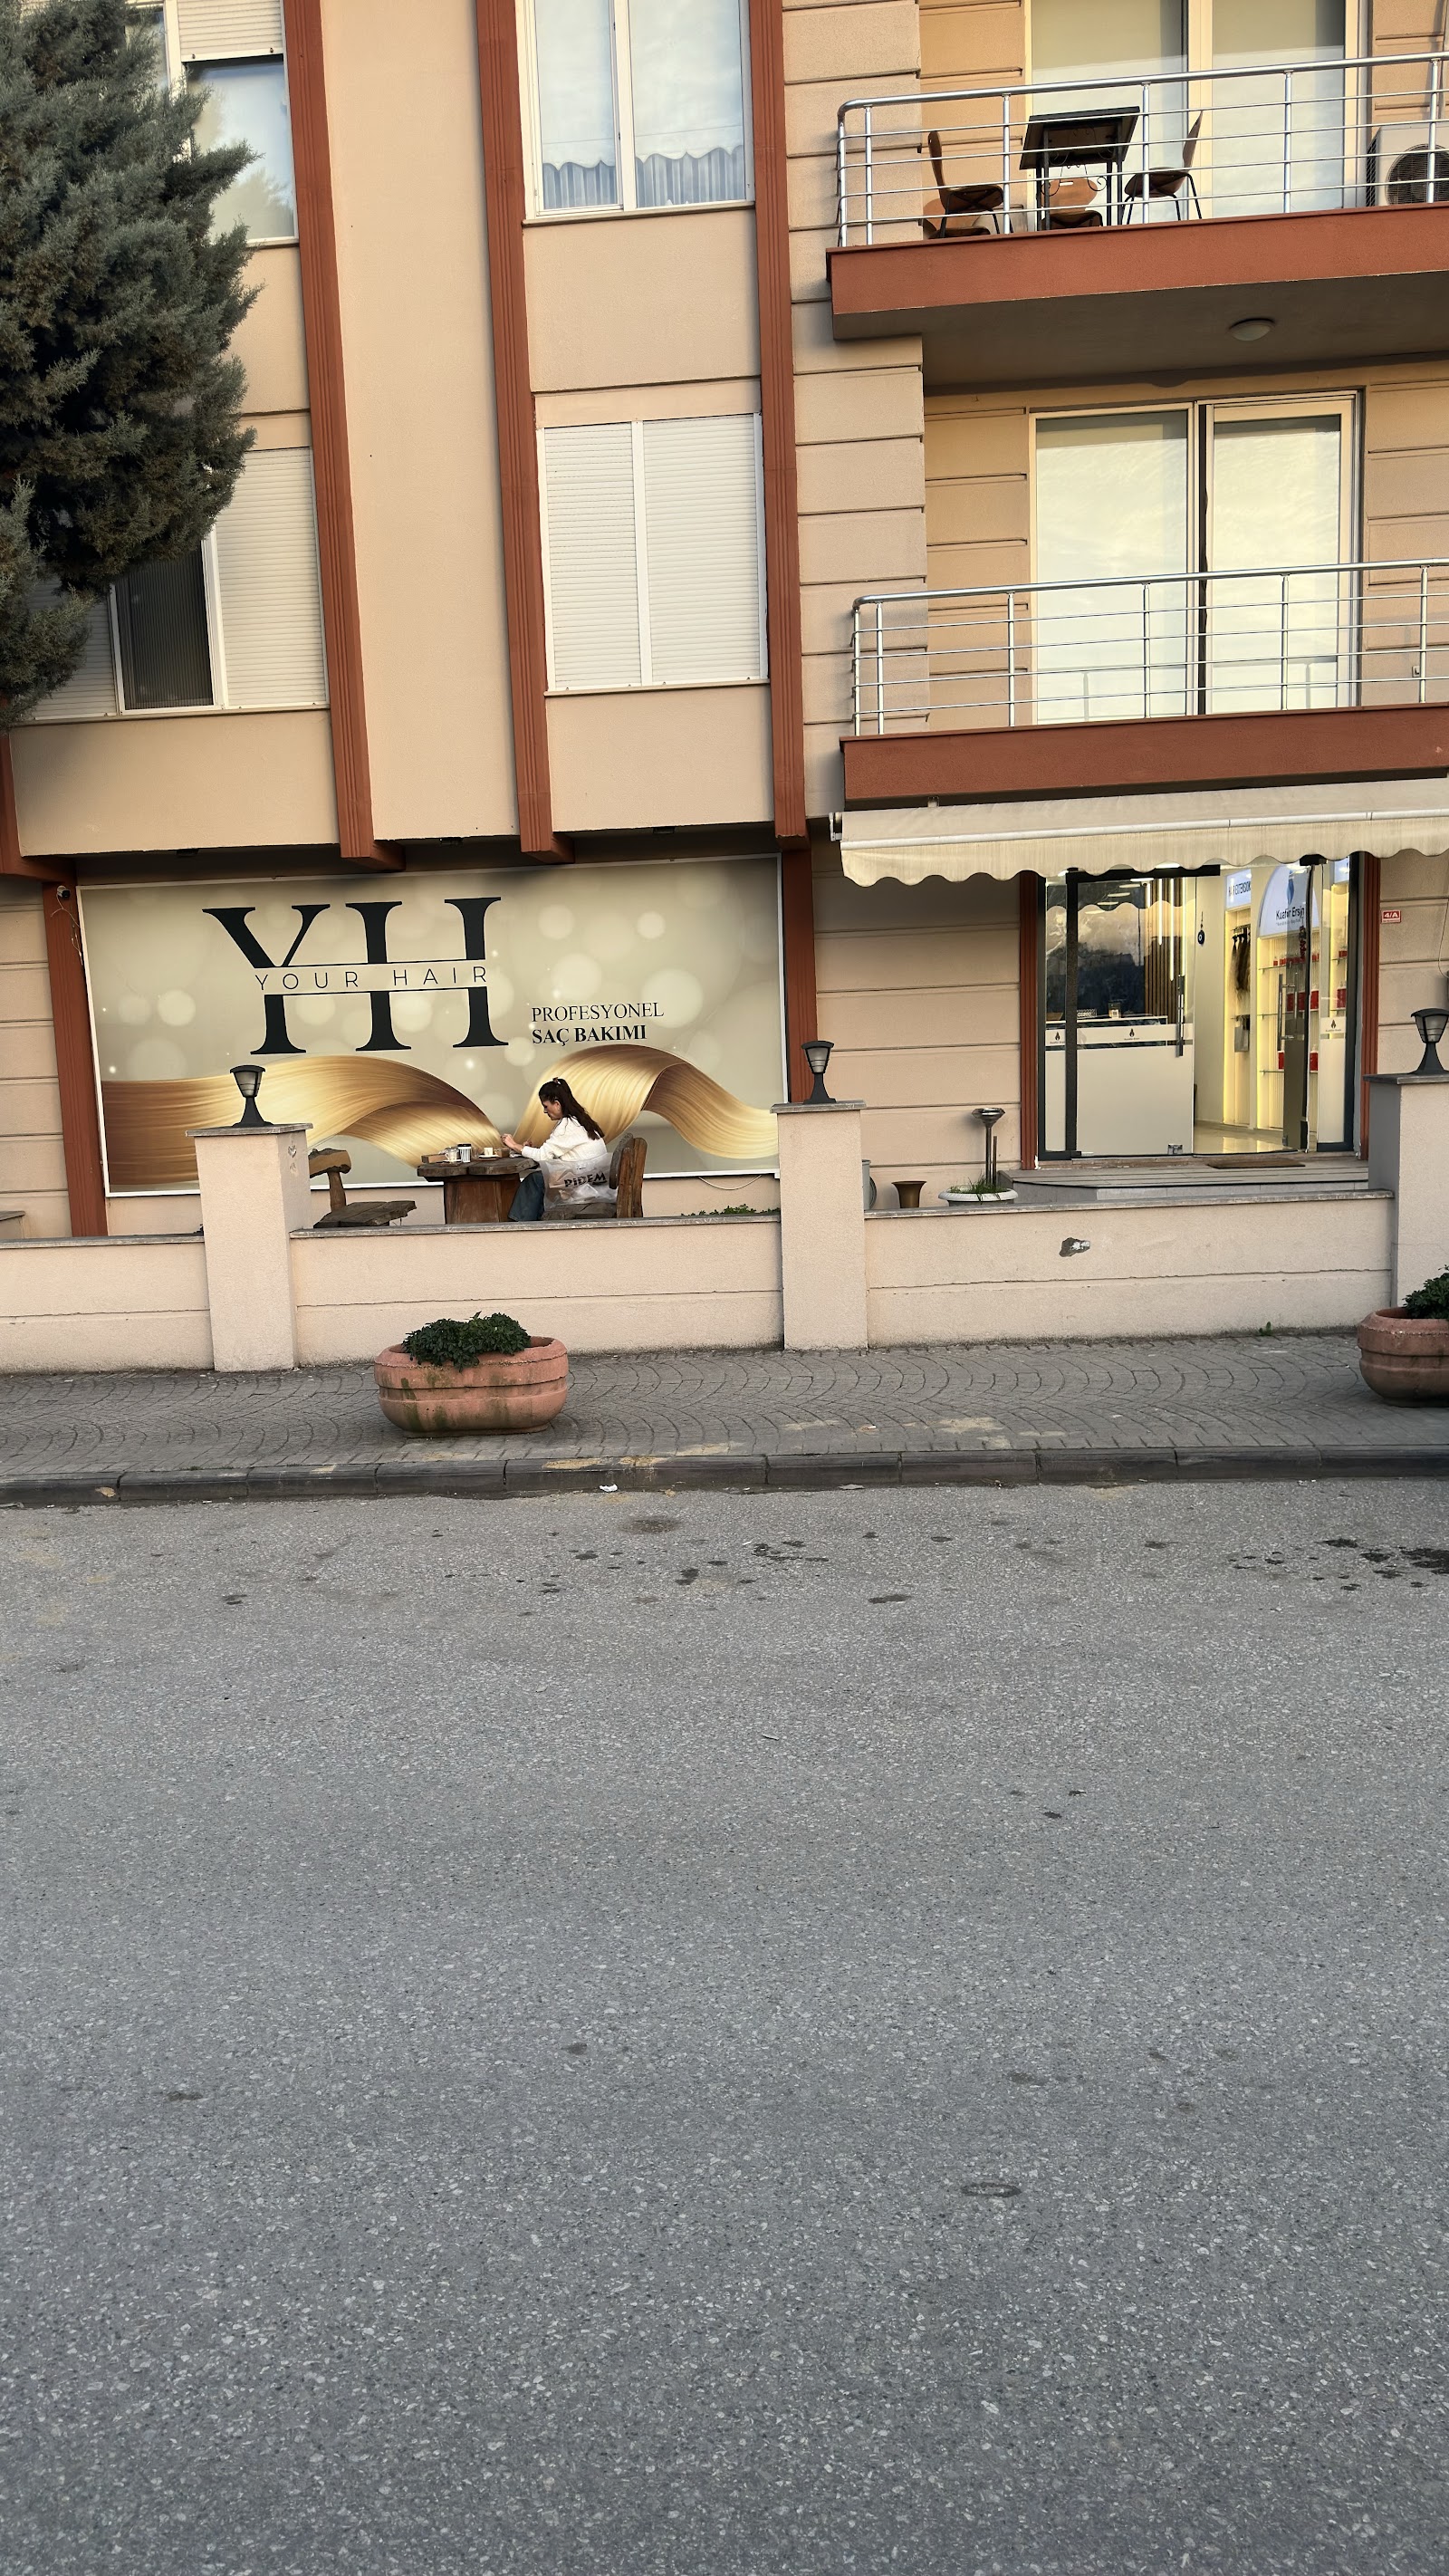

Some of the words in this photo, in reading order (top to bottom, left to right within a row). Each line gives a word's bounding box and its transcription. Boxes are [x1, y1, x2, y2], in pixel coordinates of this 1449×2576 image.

[202, 897, 509, 1055] YH
[254, 971, 359, 991] YOUR
[392, 966, 487, 986] HAIR
[531, 1002, 665, 1022] PROFESYONEL
[532, 1027, 570, 1047] SAÇ
[573, 1024, 648, 1043] BAKIMI
